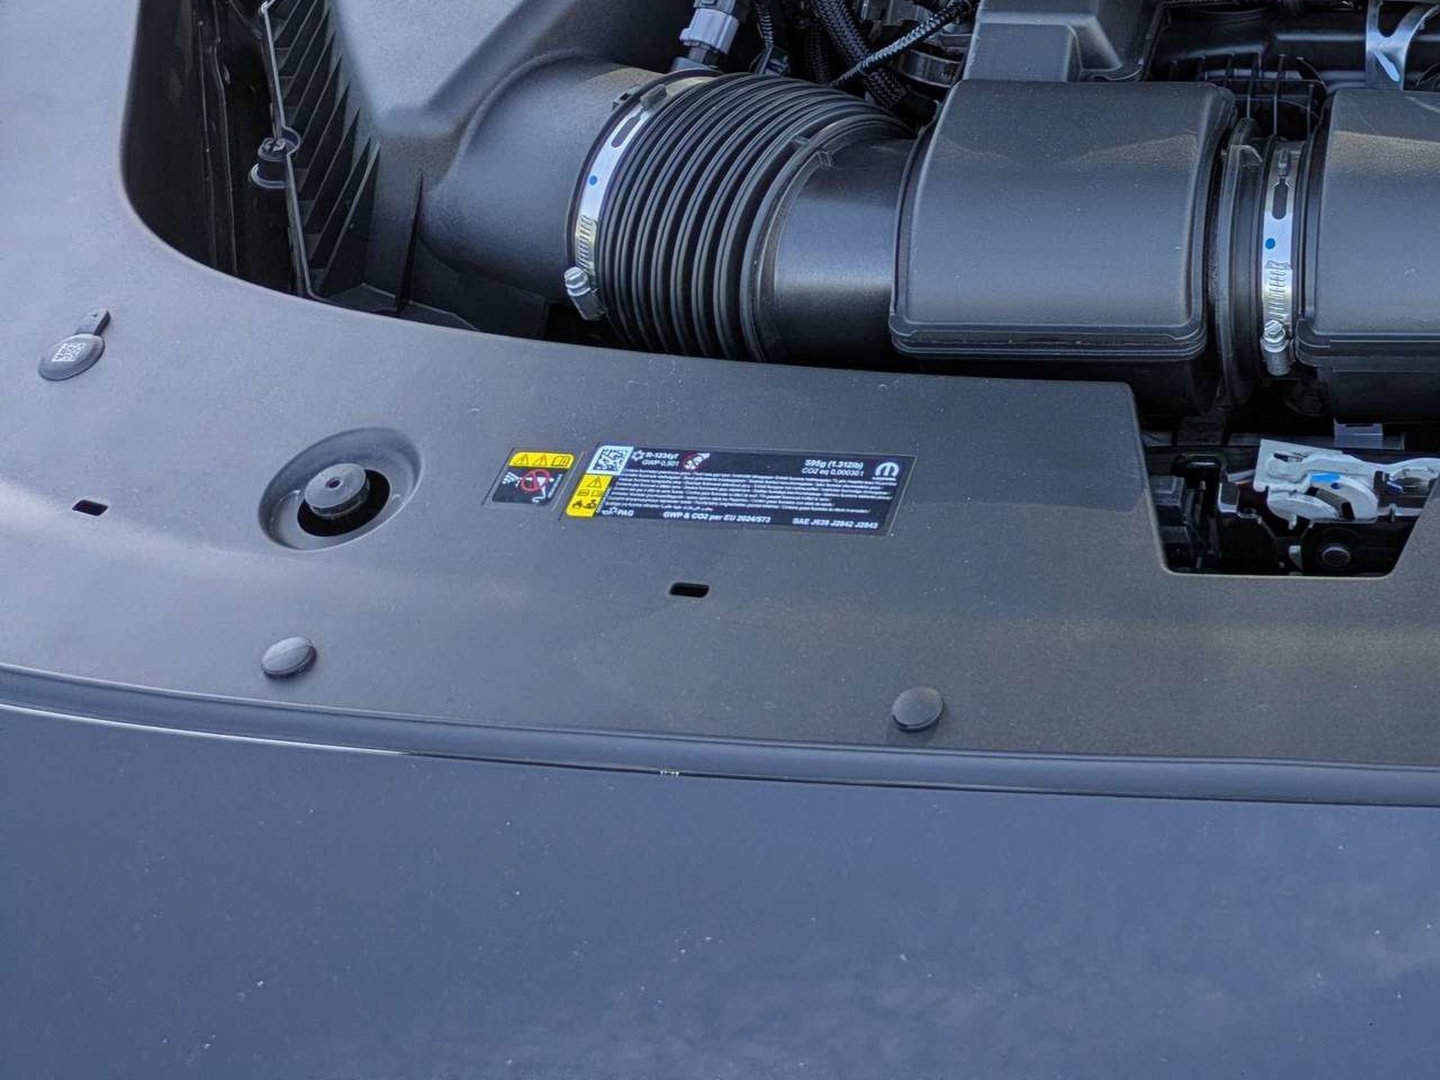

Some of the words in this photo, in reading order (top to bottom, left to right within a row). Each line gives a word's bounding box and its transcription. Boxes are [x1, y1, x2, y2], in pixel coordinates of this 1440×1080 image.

[645, 451, 680, 460] R-1234yf
[804, 459, 827, 468] 595g
[801, 467, 818, 475] CO2
[819, 468, 829, 476] eq
[662, 510, 682, 519] GWP
[691, 512, 709, 520] CO2
[708, 513, 722, 522] per
[792, 517, 810, 525] SAE
[810, 518, 830, 527] J639
